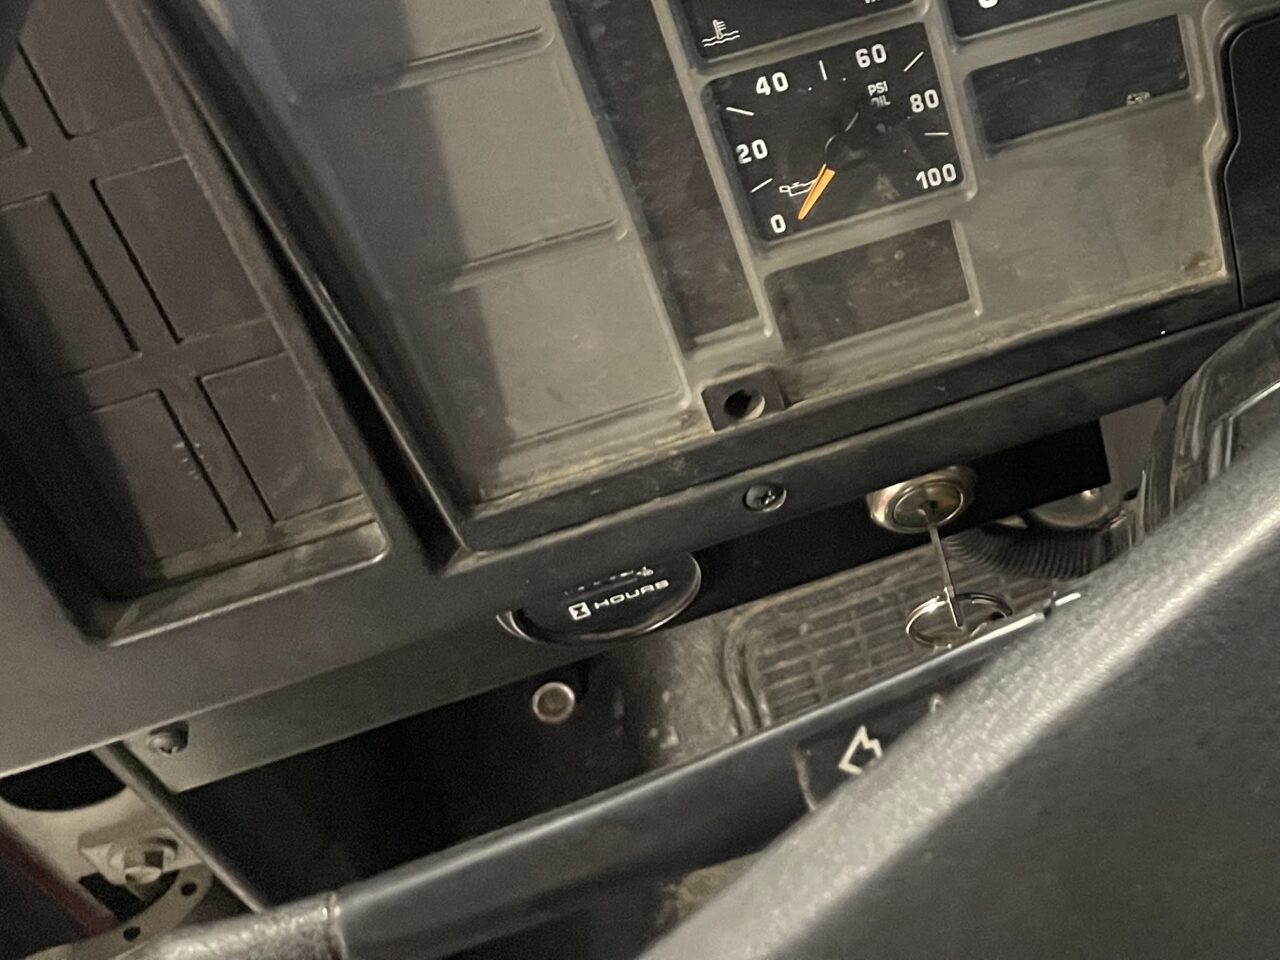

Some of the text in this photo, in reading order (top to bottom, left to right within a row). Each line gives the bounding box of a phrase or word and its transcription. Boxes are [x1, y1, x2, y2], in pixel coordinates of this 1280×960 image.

[855, 43, 887, 68] 60
[755, 71, 789, 96] 40
[867, 80, 889, 96] PSI
[909, 89, 940, 113] 80
[736, 139, 768, 164] 20
[915, 163, 957, 190] 100
[770, 214, 786, 234] 0
[594, 579, 669, 610] HOURS
